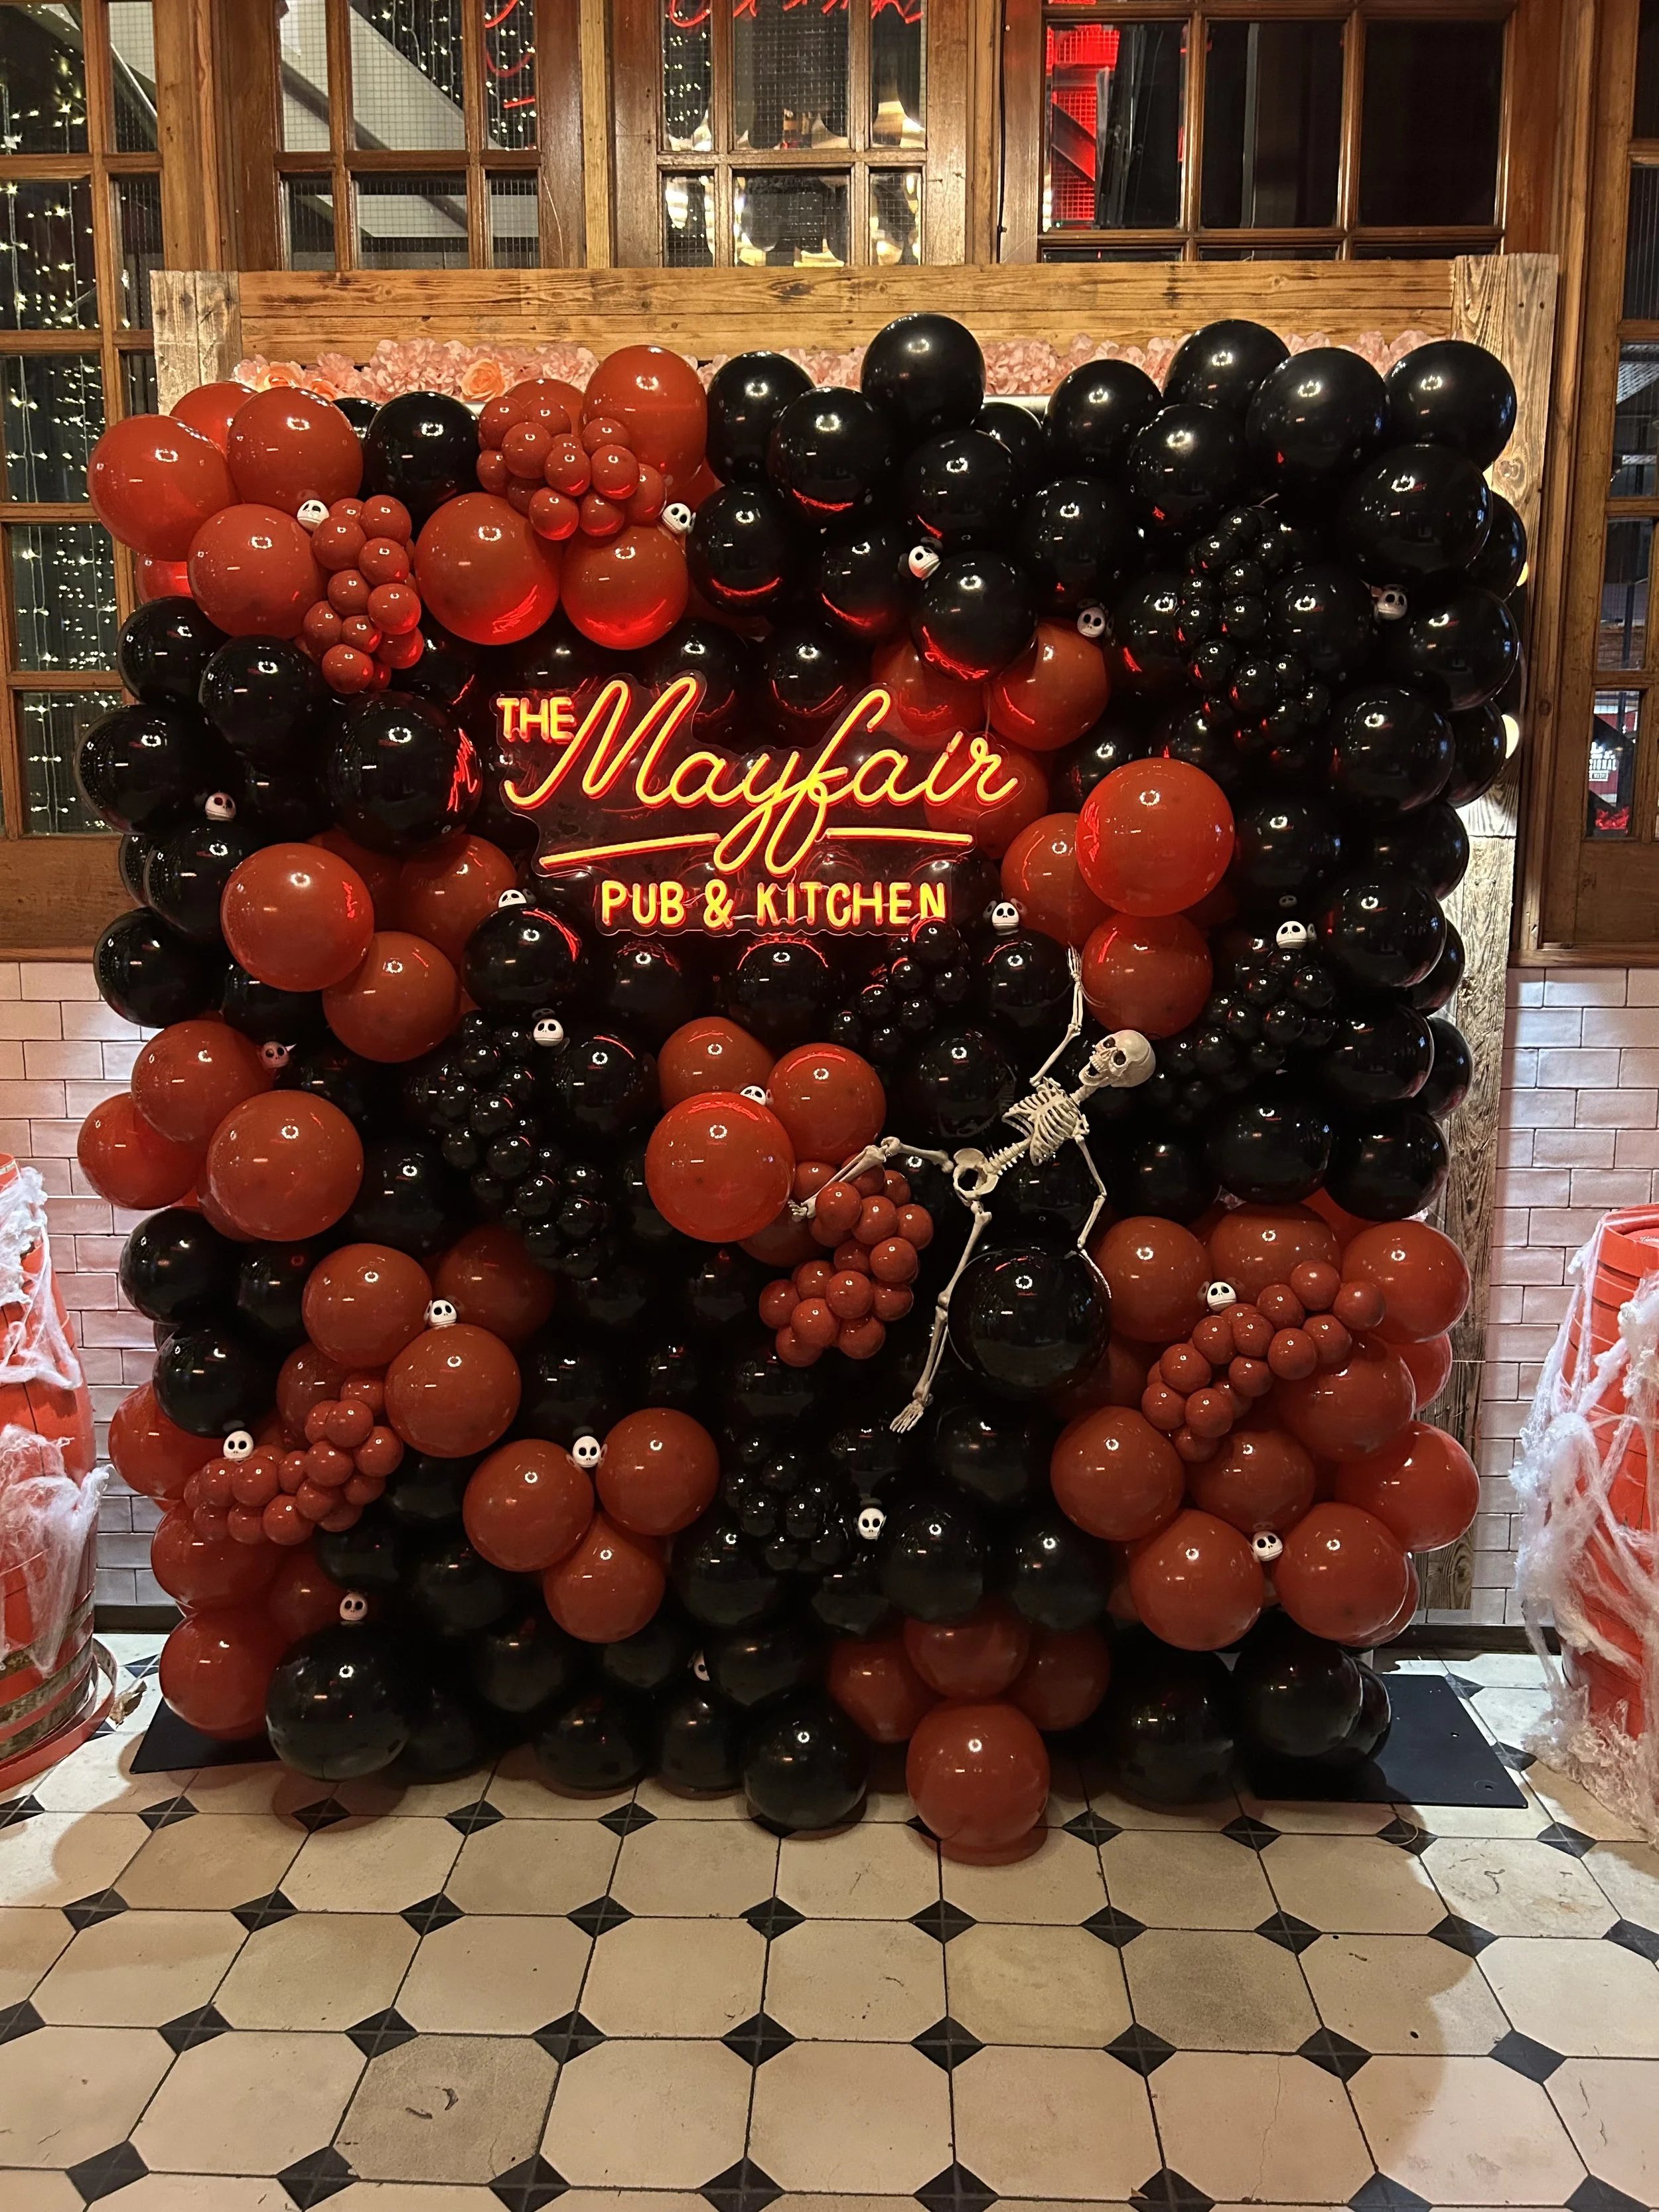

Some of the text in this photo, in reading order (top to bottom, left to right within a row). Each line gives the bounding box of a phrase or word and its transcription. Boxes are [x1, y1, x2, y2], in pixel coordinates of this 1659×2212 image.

[496, 676, 1019, 874] THE Mayfair
[601, 879, 946, 928] PUB & KITCHEN
